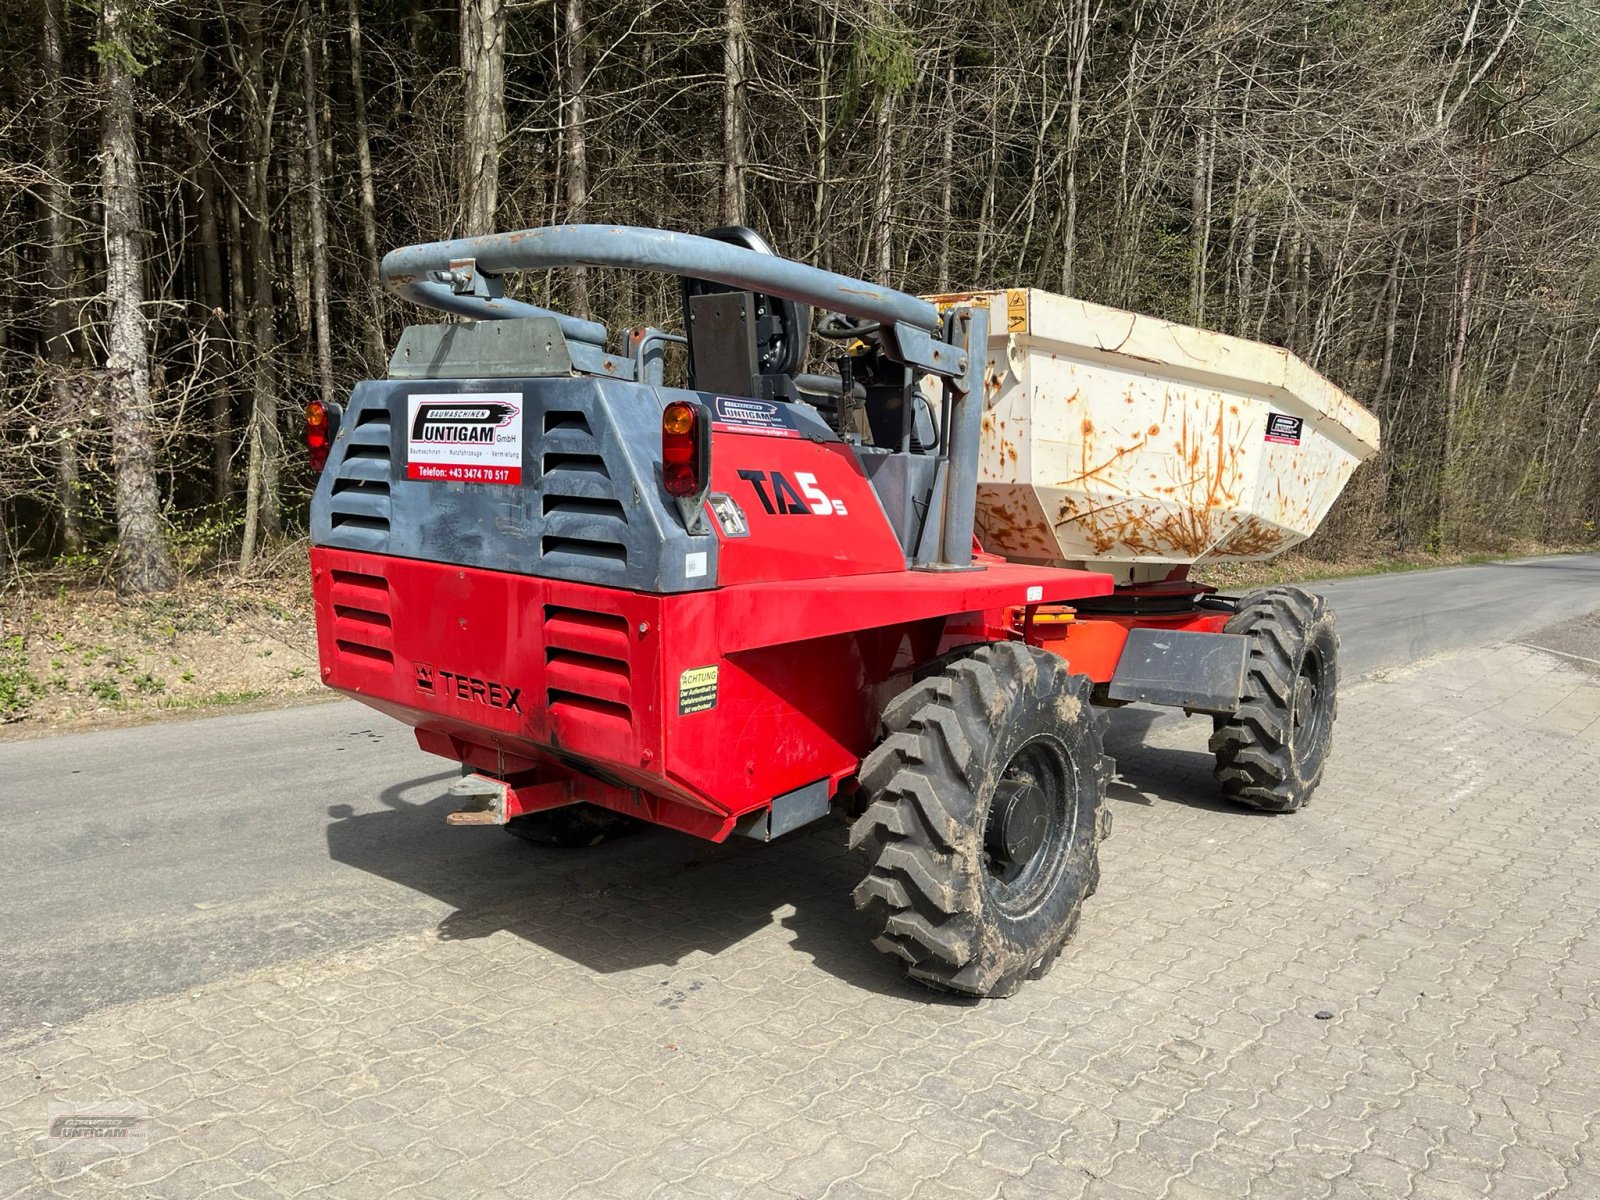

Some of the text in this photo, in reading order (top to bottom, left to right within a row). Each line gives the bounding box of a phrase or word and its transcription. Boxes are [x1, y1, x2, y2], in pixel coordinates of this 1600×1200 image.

[429, 410, 487, 418] BAUMASCHINEN
[496, 434, 516, 443] GmbH
[410, 447, 519, 459] Baumaschinen Nutzfahrzeuge Vermietung
[419, 466, 509, 480] Telefon: +43 3474 70 517
[681, 670, 716, 685] ACHTUNG
[438, 670, 523, 714] TEREX
[689, 685, 711, 696] Aufenthalt
[680, 693, 716, 706] Gefahrenbereich
